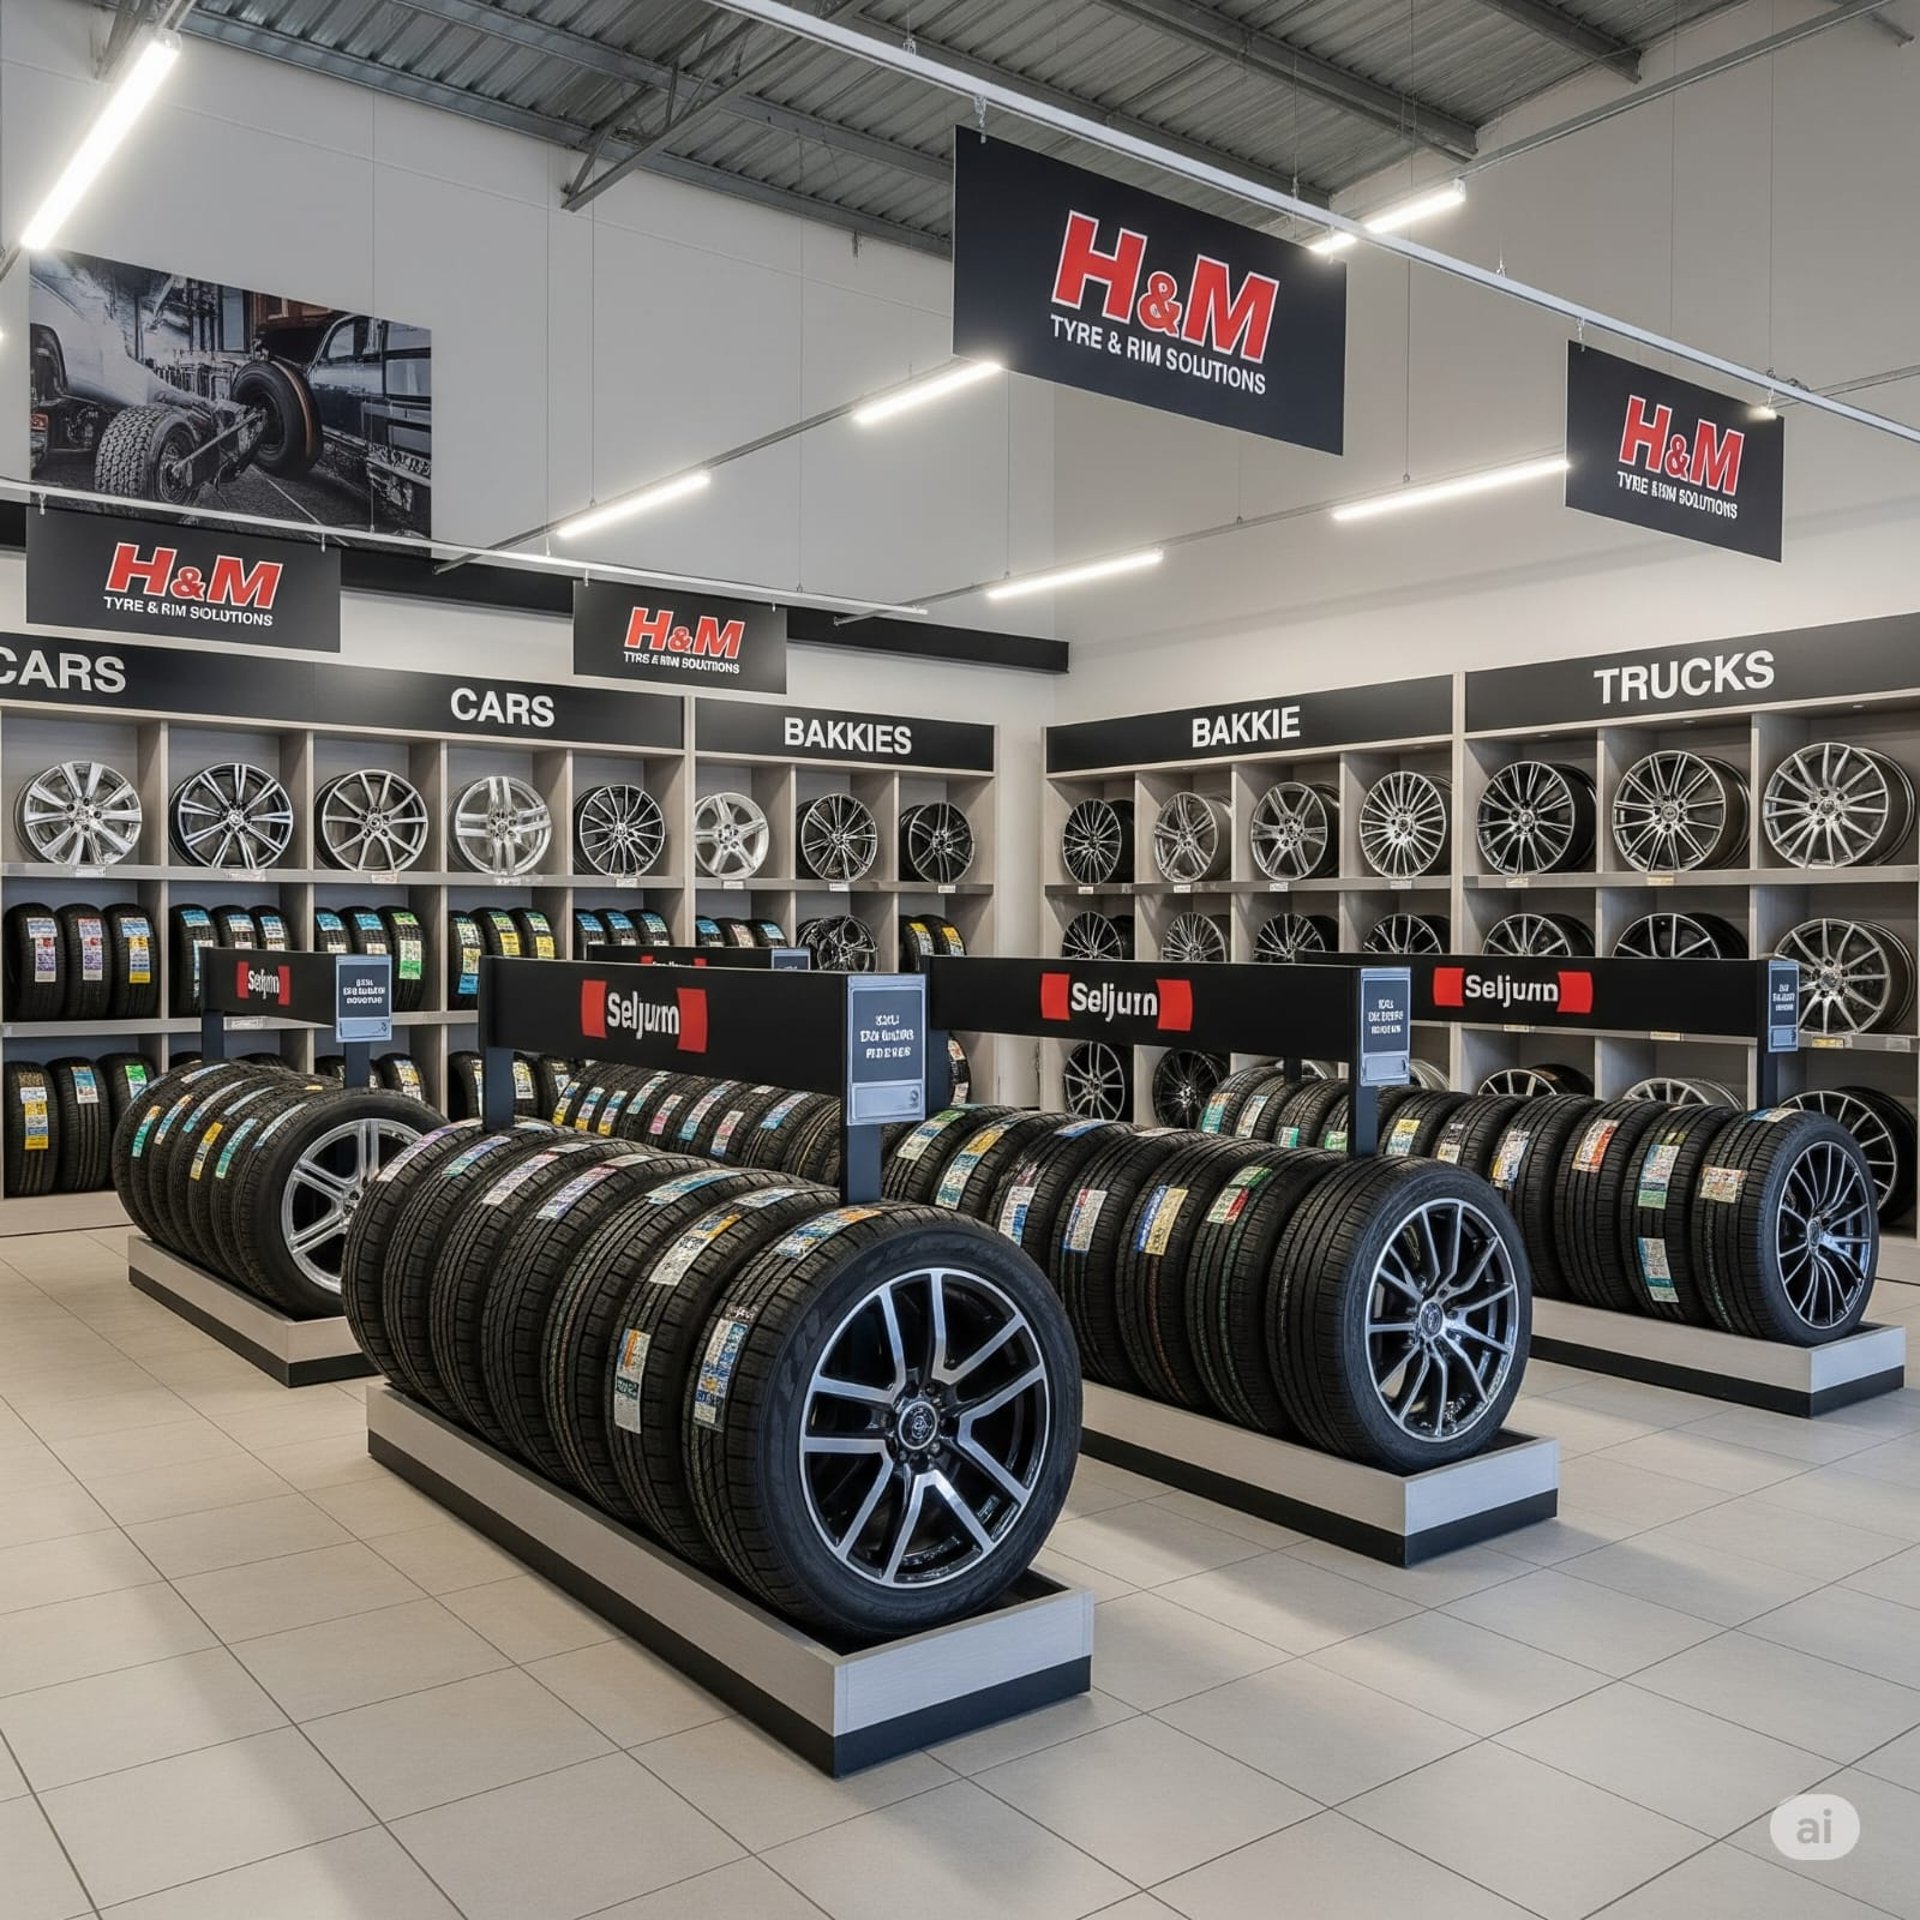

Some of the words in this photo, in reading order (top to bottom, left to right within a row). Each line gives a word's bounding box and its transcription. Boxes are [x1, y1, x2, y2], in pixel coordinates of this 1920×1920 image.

[1051, 209, 1281, 364] H&M
[1050, 313, 1103, 351] TYRE
[1107, 331, 1122, 355] &
[1126, 337, 1162, 367] RIM
[1165, 348, 1267, 395] SOLUTIONS
[1618, 394, 1745, 497] H&M
[105, 541, 284, 610] H&M
[103, 596, 144, 613] TYRE
[147, 601, 159, 615] &
[161, 602, 187, 617] RIM
[189, 605, 274, 627] SOLUTIONS
[624, 606, 746, 659] H&M
[1593, 649, 1776, 705] TRUCKS
[450, 687, 555, 728] CARS
[1191, 705, 1301, 749] BAKKIE
[784, 716, 913, 755] BAKKIES
